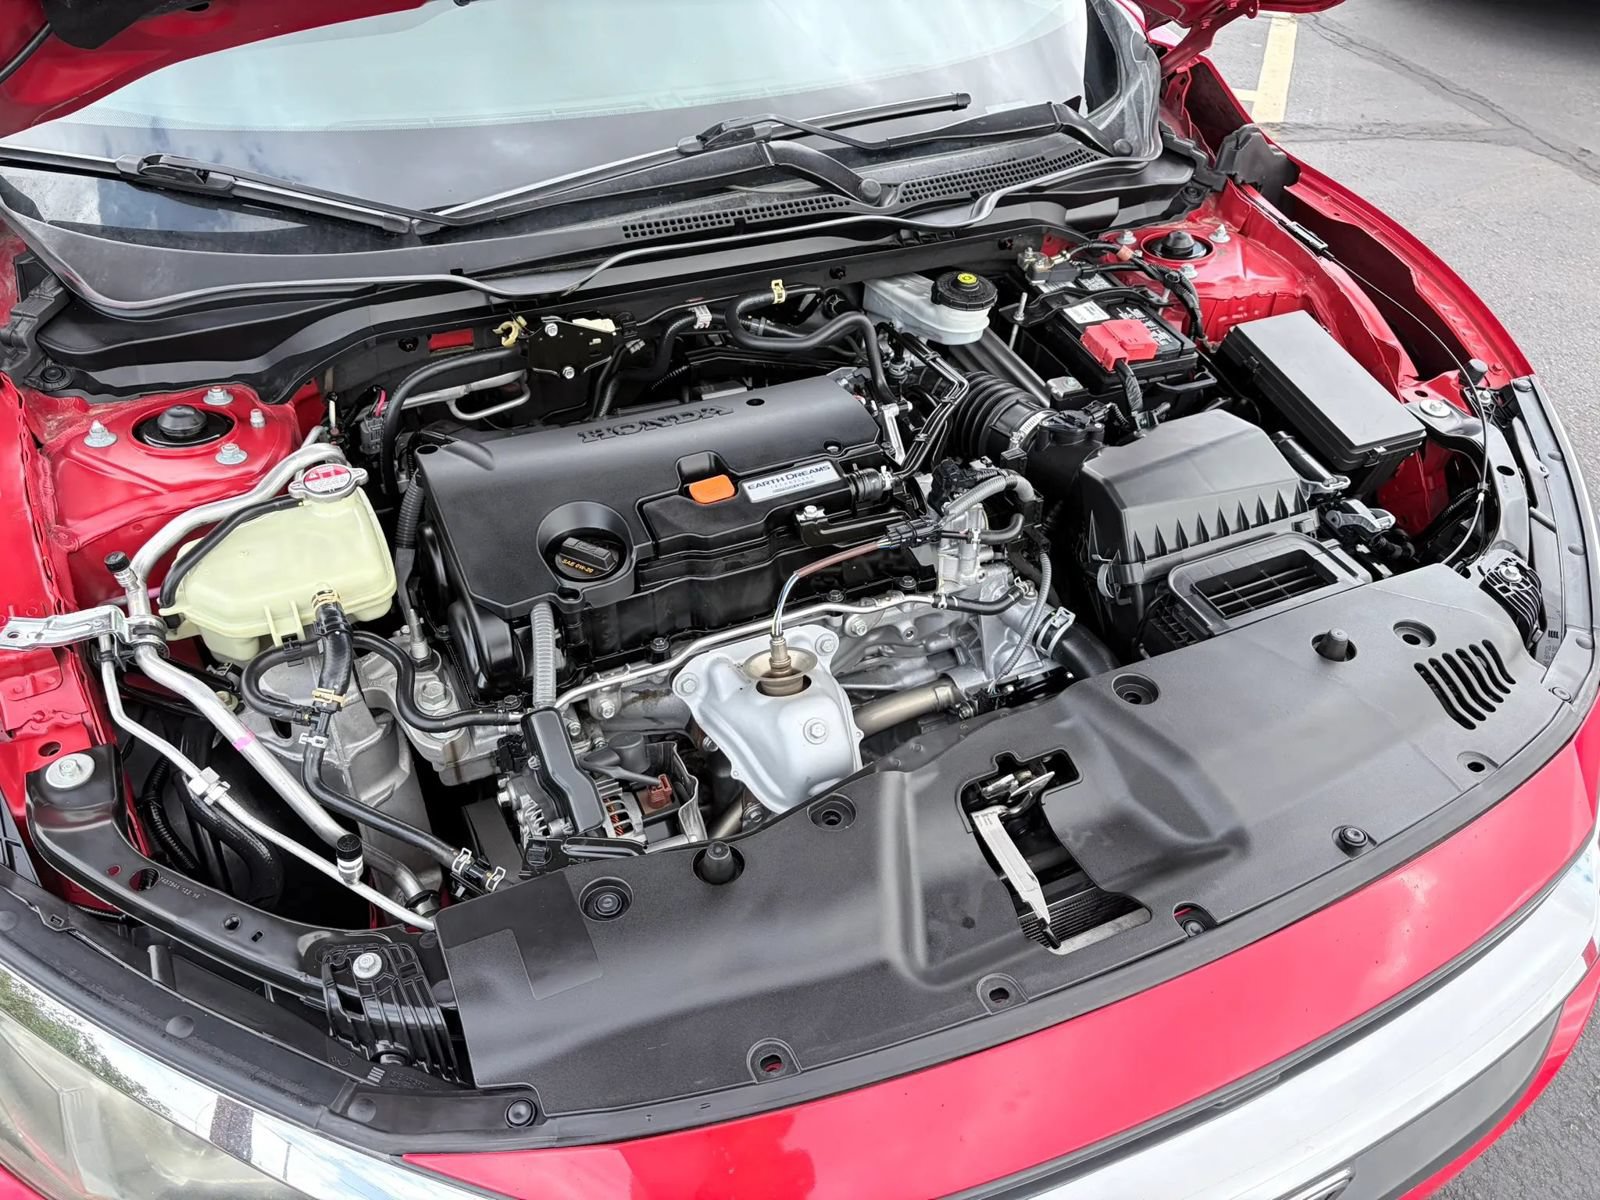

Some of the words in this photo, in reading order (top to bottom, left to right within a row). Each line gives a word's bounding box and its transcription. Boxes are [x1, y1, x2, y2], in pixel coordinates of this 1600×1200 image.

[577, 406, 733, 443] HONDA
[747, 476, 785, 491] EARTH
[561, 558, 575, 567] SAE
